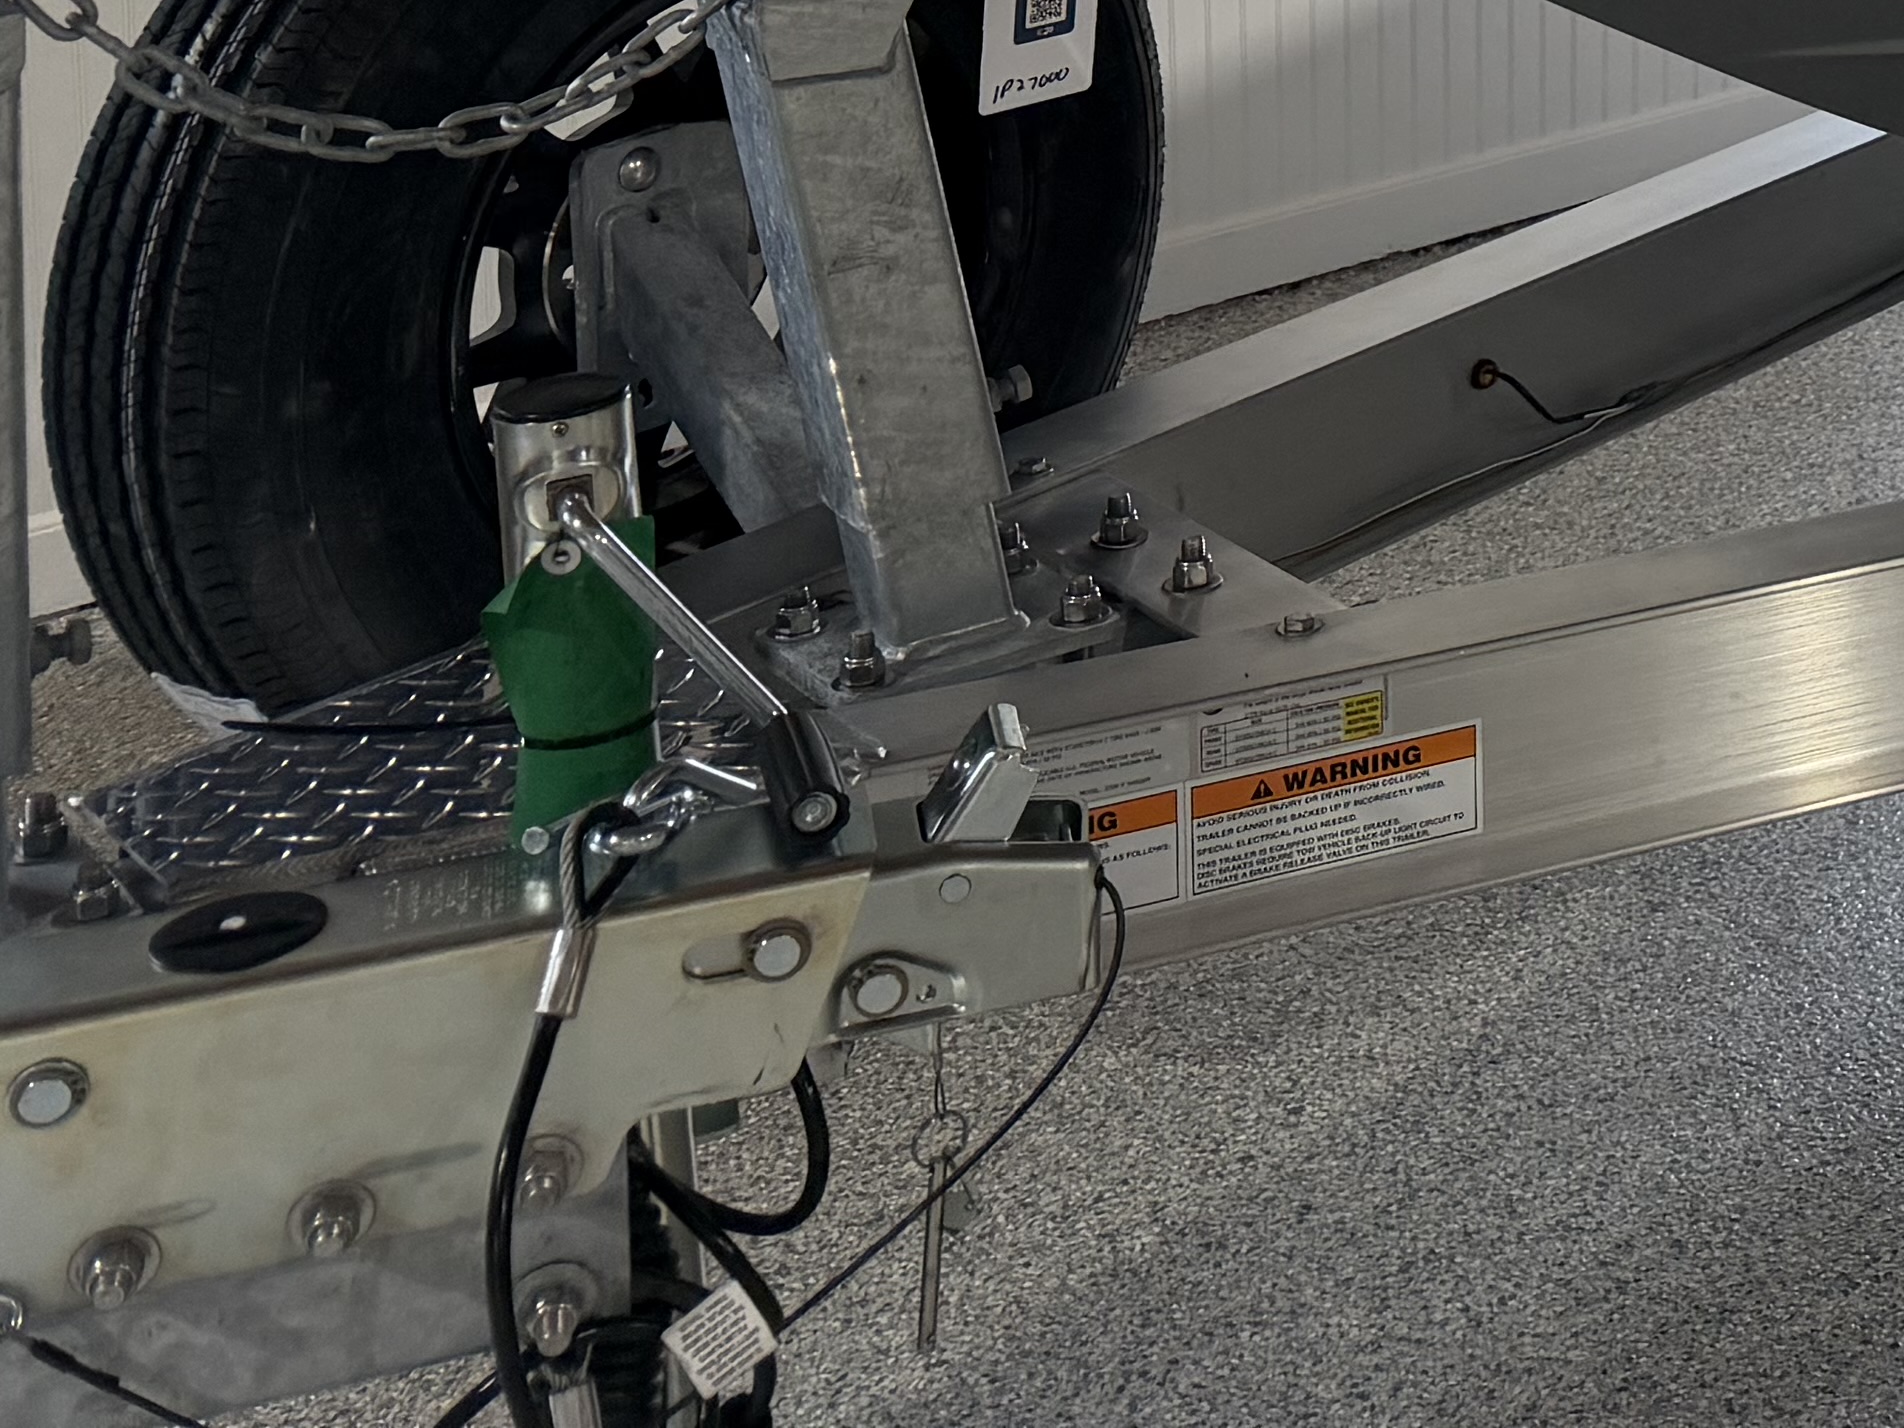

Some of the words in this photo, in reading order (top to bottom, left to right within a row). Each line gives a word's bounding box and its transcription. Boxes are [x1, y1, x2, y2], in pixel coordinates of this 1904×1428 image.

[1283, 745, 1422, 792] WARNING
[1196, 828, 1234, 842] TRAILER
[1236, 819, 1273, 833] CANNOT
[1290, 806, 1327, 821] BACKED
[1354, 788, 1413, 806] INCORRECTLY
[1226, 806, 1267, 822] SERIOUS
[1305, 795, 1318, 804] OR
[1320, 788, 1351, 800] DEATH
[1353, 781, 1379, 794] FROM
[1454, 811, 1465, 820] TO
[1197, 843, 1234, 857] SPECIAL
[1236, 830, 1291, 848] ELECTRICAL
[1219, 851, 1257, 864] TRAILER
[1317, 831, 1338, 842] WITH
[1197, 874, 1239, 889] ACTIVATE
